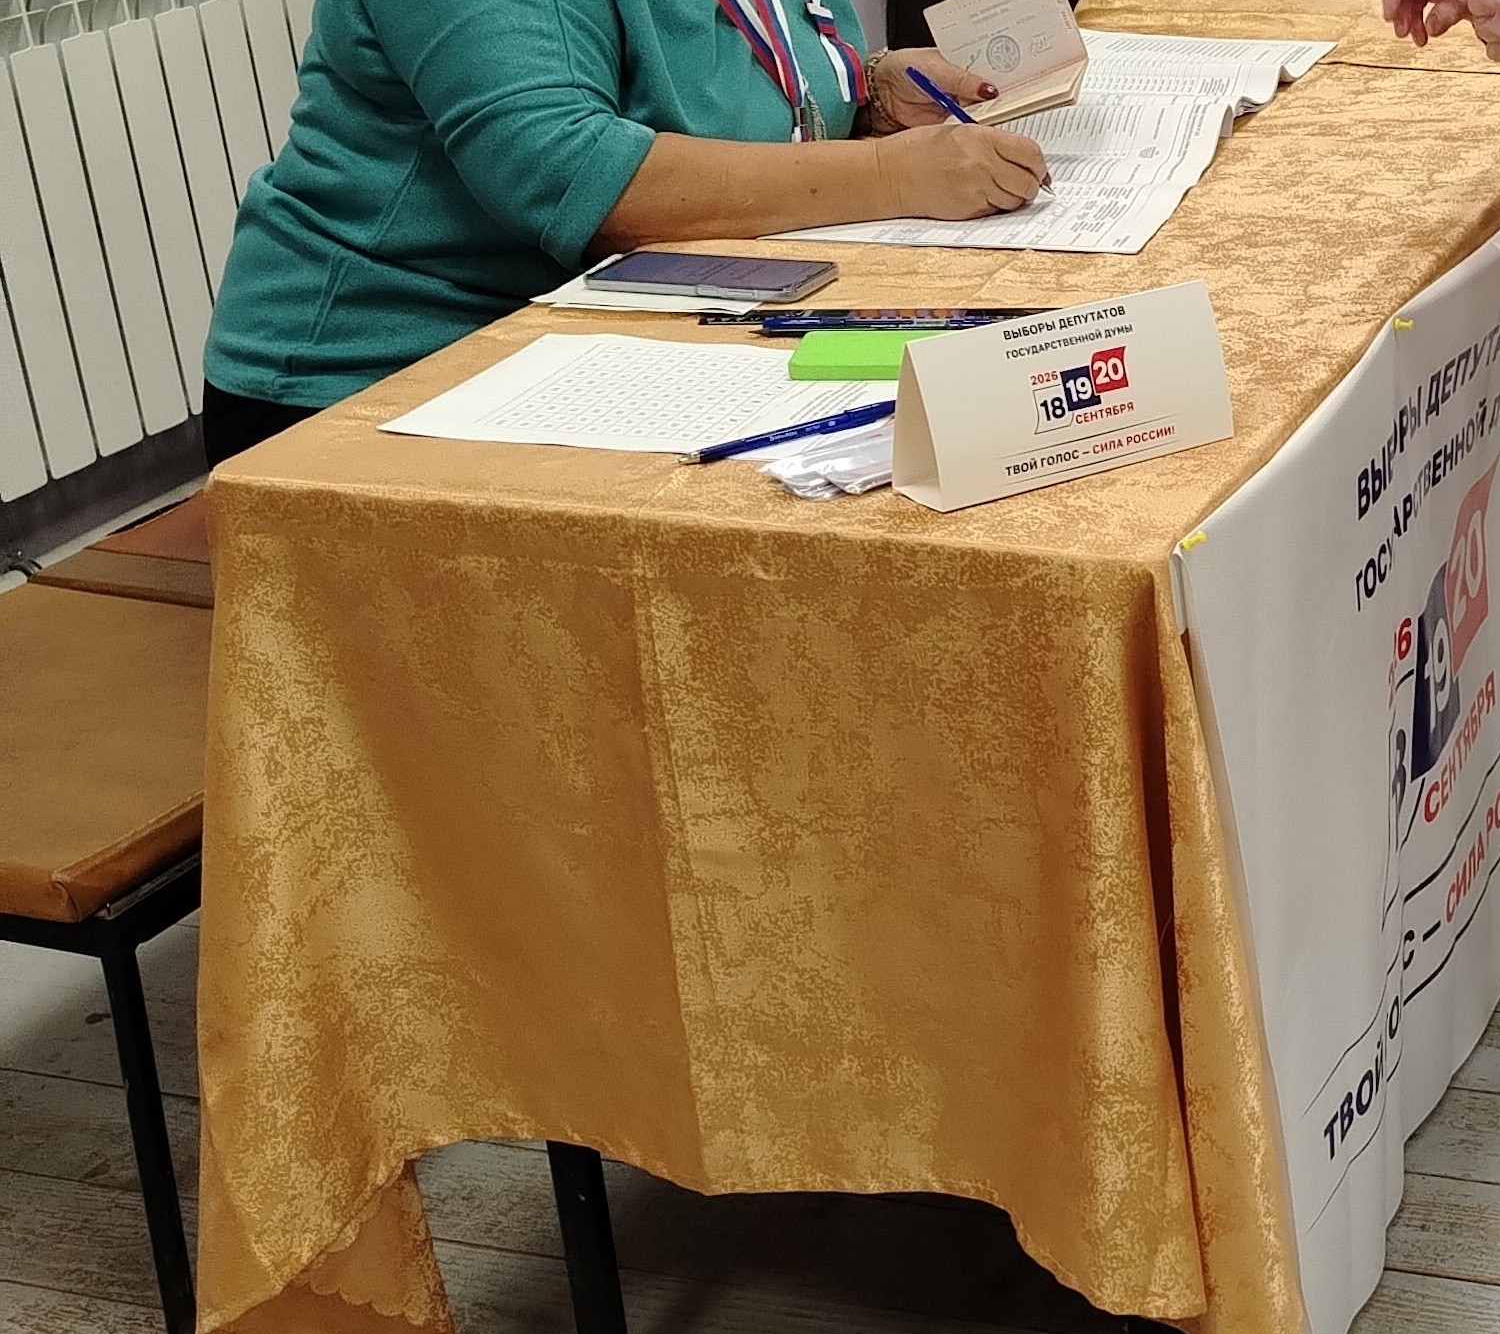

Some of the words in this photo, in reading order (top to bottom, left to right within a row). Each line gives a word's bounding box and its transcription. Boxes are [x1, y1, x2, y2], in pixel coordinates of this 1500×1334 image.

[1003, 320, 1056, 340] ВЫБОРЫ
[1058, 305, 1126, 330] ДЕПУТАТОВ
[1006, 329, 1103, 359] ГОСУДАРСТВЕННОЙ
[1104, 324, 1134, 339] ДУМЫ
[1030, 371, 1058, 385] 2026
[1040, 396, 1066, 422] 18
[1065, 376, 1092, 403] 19
[1092, 357, 1124, 385] 20
[1075, 401, 1134, 425] СЕНТЯБРЯ
[1005, 457, 1038, 477] ТВОЙ
[1040, 449, 1080, 468] ГОЛОС
[1092, 437, 1124, 455] СИЛА
[1126, 425, 1175, 446] РОССИИ!
[1424, 617, 1449, 735] 19
[1451, 508, 1483, 635] 20
[1423, 669, 1497, 823] СЕНТЯБРЯ
[1445, 830, 1486, 924] СИЛА
